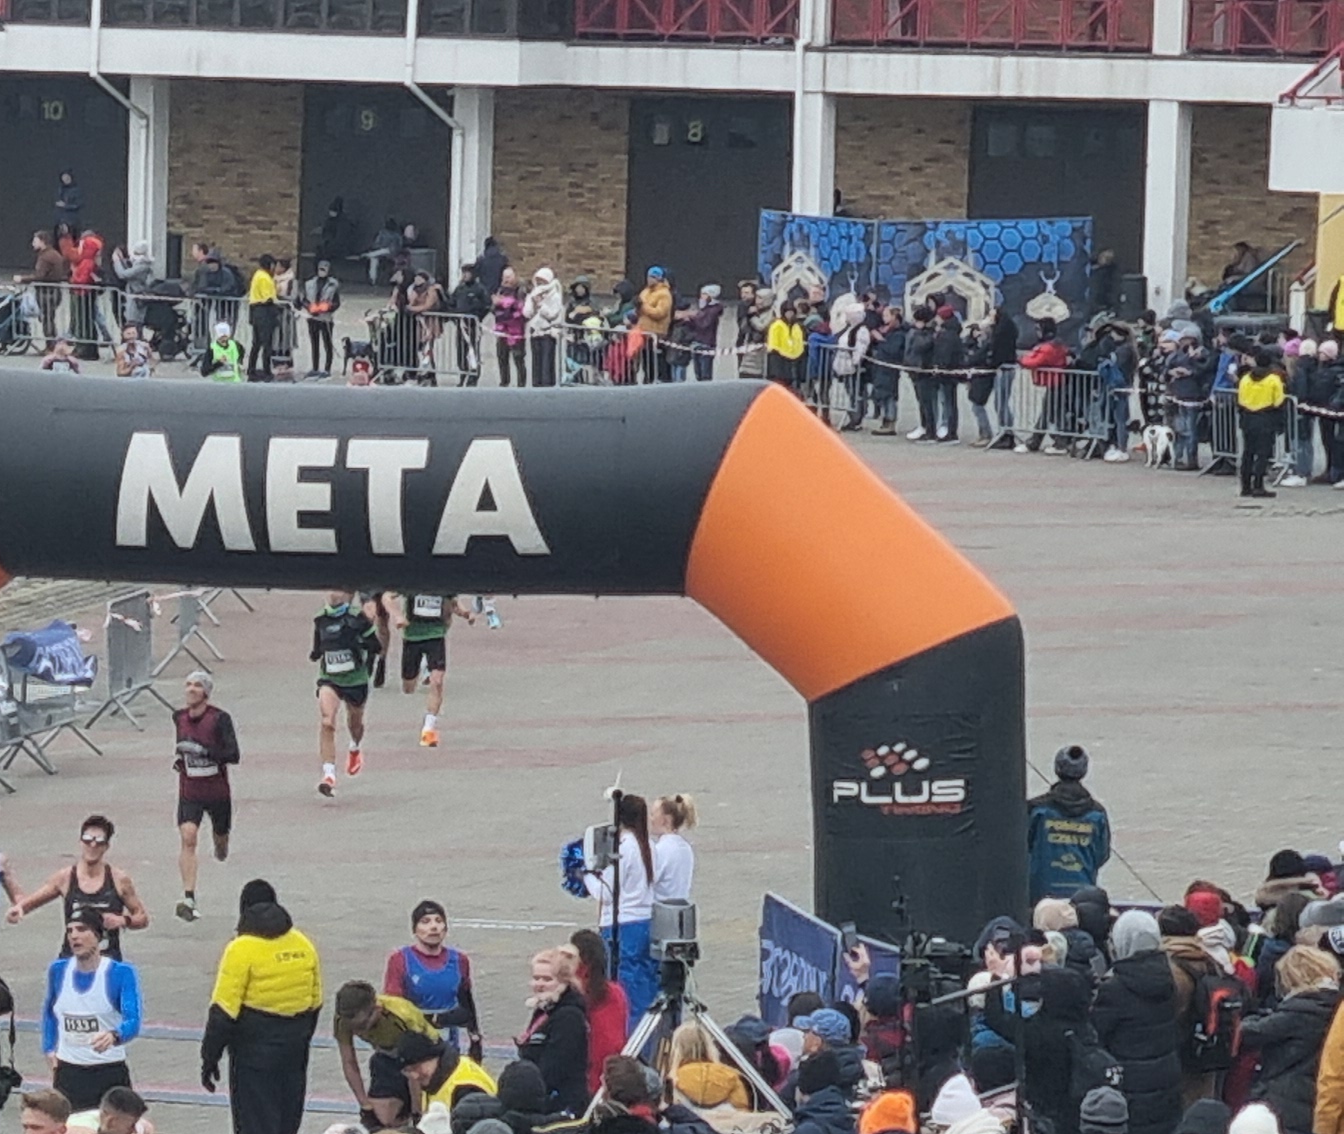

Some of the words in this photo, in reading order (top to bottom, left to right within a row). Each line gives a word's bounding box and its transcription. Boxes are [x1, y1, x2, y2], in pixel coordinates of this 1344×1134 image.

[42, 101, 62, 120] 10
[360, 110, 374, 131] 9
[687, 120, 703, 142] 8
[115, 432, 551, 556] META
[833, 779, 965, 804] PLUS
